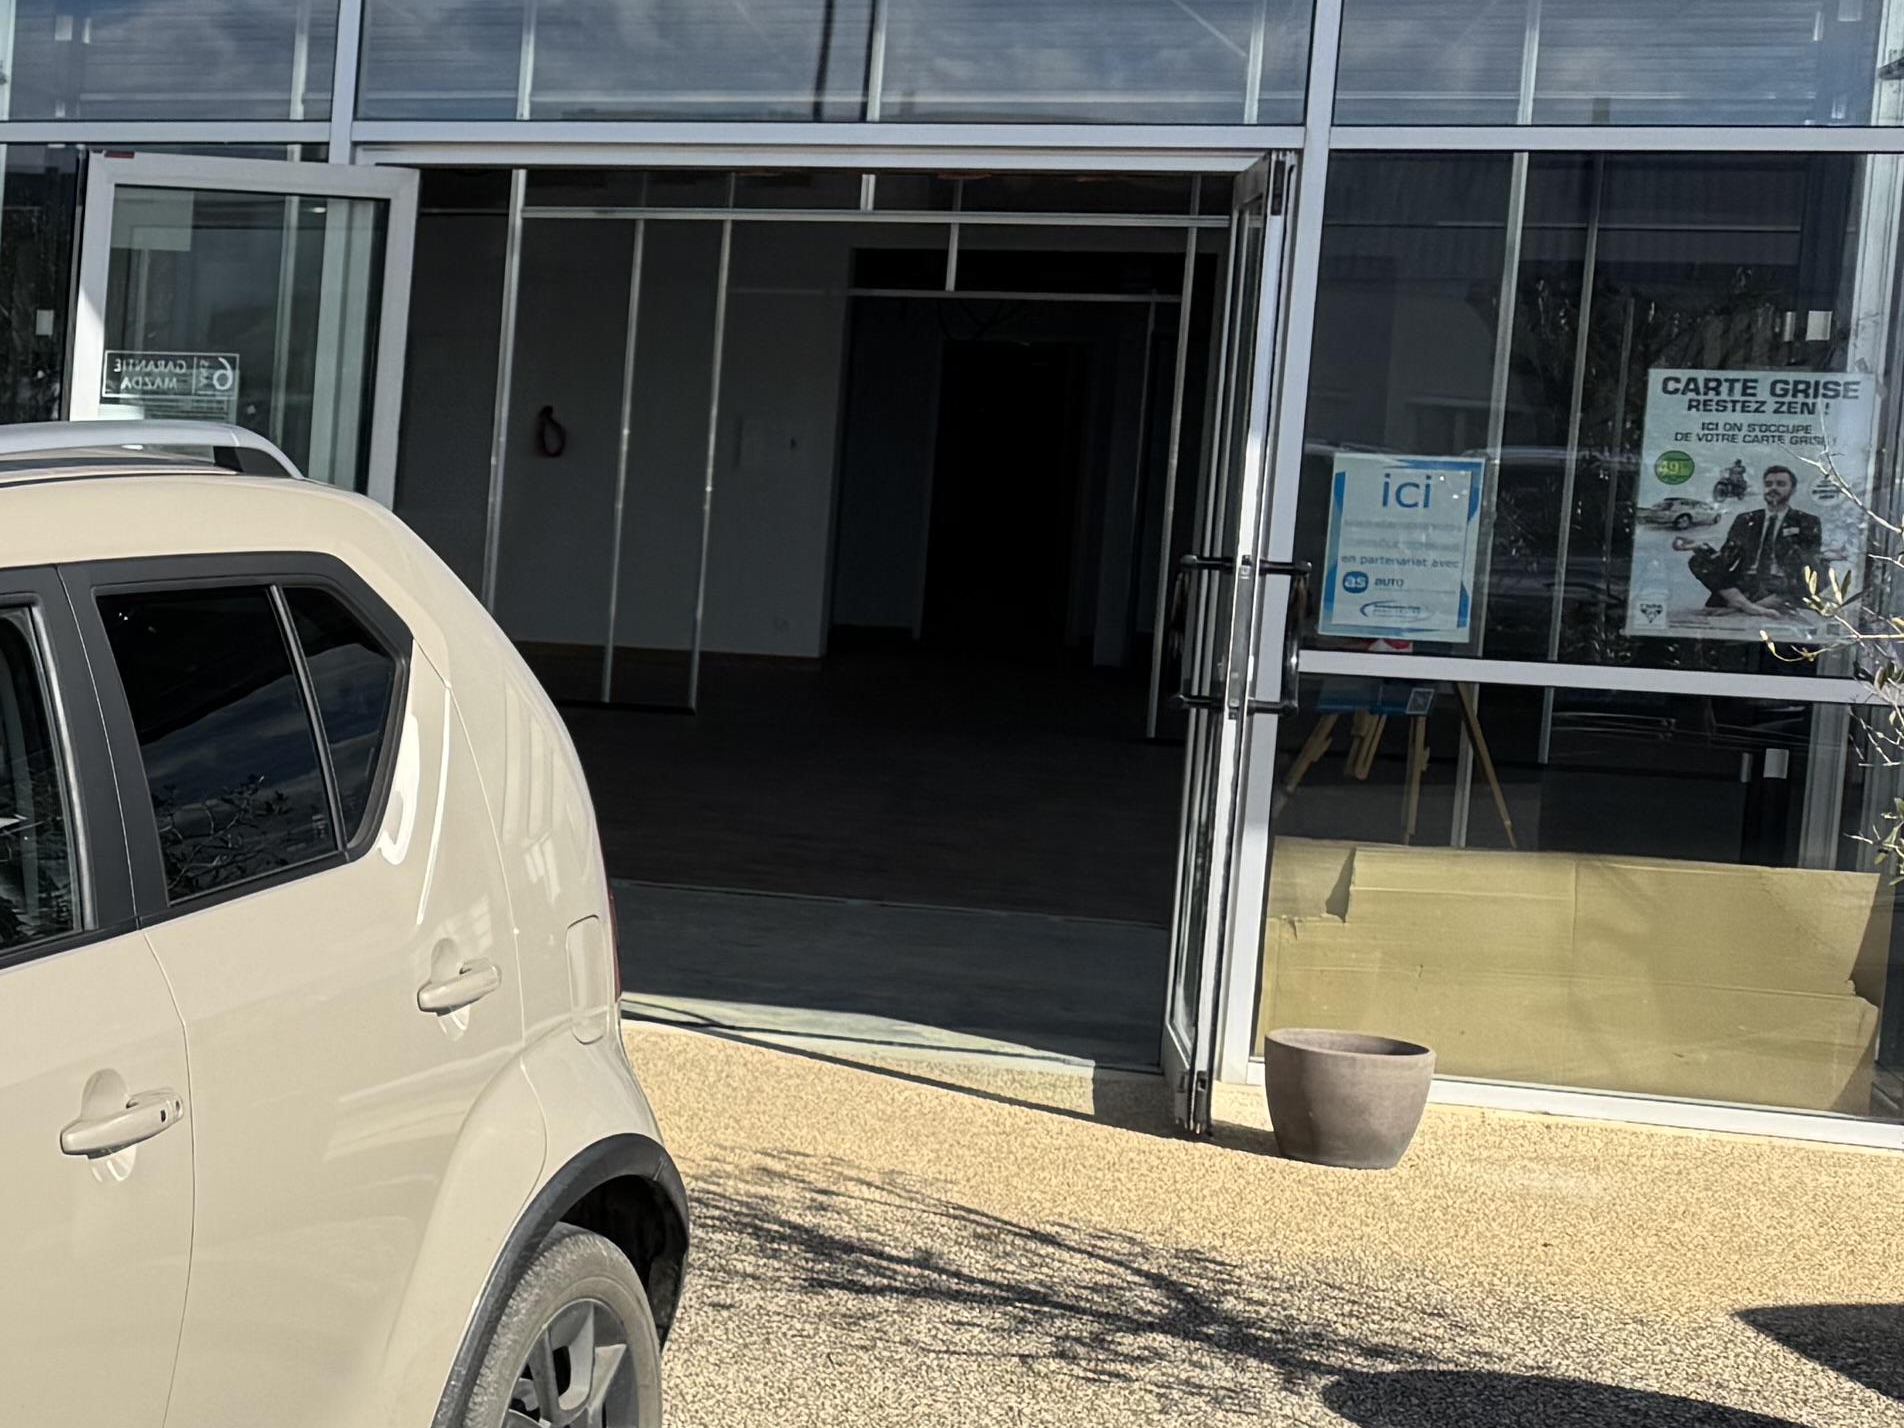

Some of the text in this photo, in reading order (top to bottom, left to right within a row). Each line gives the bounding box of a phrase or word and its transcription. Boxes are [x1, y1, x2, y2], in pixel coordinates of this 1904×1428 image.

[1661, 376, 1862, 400] CARTE GRISE
[1687, 398, 1768, 414] RESTEZ
[1772, 400, 1817, 415] ZEN
[1701, 421, 1813, 435] ICI ON S'OCCUPE
[1674, 431, 1692, 442] DE
[1697, 432, 1739, 444] VOTRE
[1742, 433, 1786, 445] CARTE
[1382, 472, 1432, 509] ici
[1341, 555, 1460, 569] en partenariat avec
